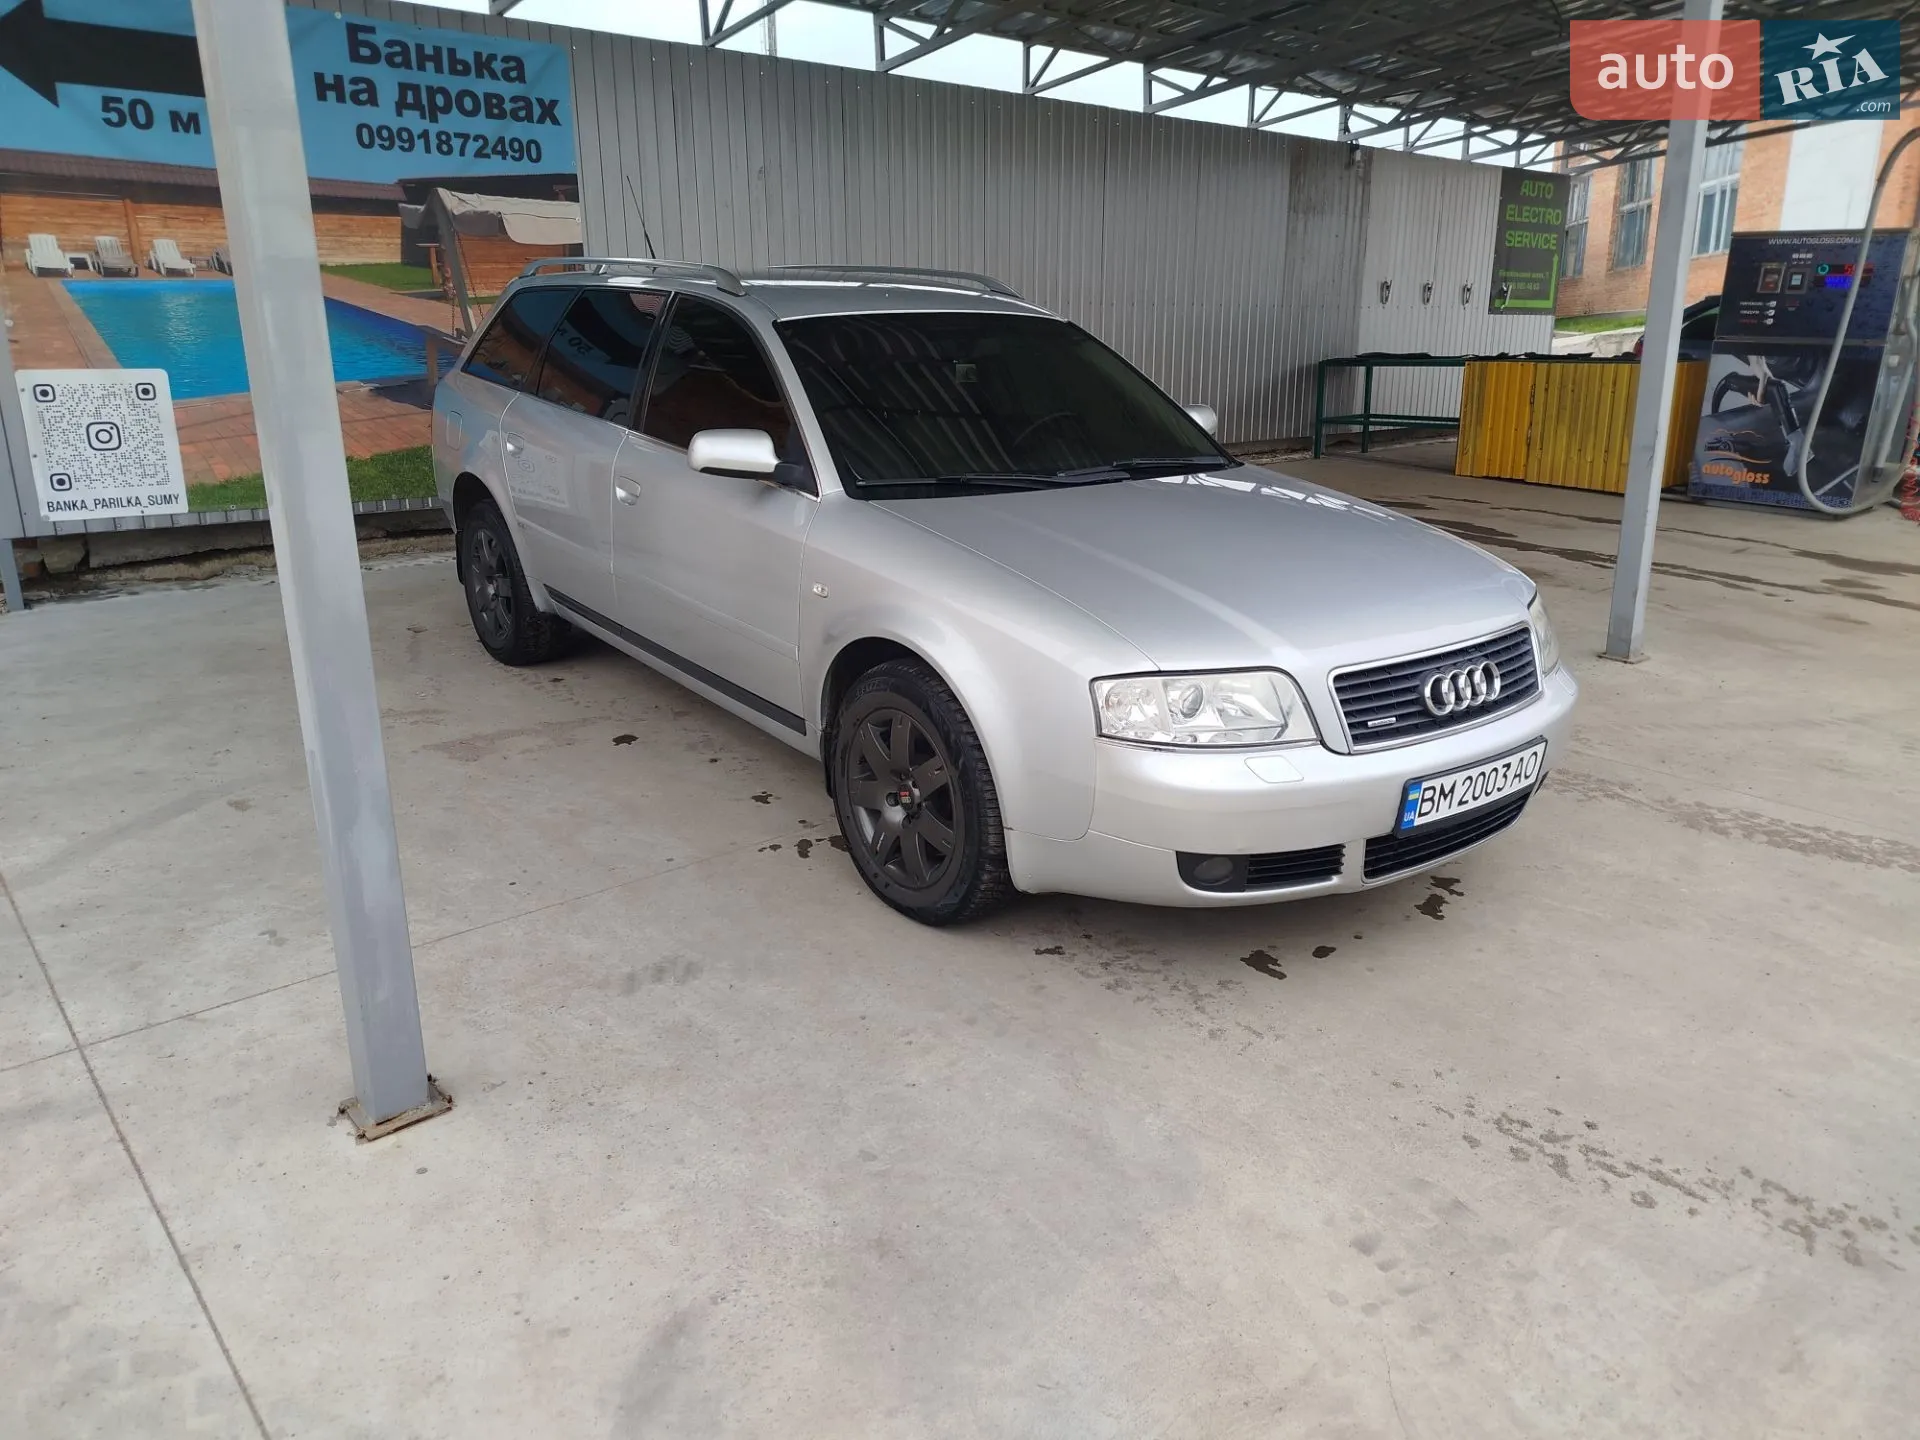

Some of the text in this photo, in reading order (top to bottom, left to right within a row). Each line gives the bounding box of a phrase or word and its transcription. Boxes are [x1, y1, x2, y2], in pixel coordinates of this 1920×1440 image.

[346, 22, 526, 84] Банька
[314, 72, 562, 126] на дровах
[101, 95, 201, 135] 50 м
[356, 123, 542, 163] 0991872490
[1520, 180, 1553, 199] AUTO
[1506, 204, 1562, 225] ELECTRO
[1505, 230, 1558, 249] SERVICE
[1768, 237, 1862, 246] WWW.AUTOGLOSS.COM.U
[1702, 463, 1770, 485] autogloss
[47, 494, 180, 513] BANKA_PARILKA_SUMY
[1404, 811, 1415, 822] UA
